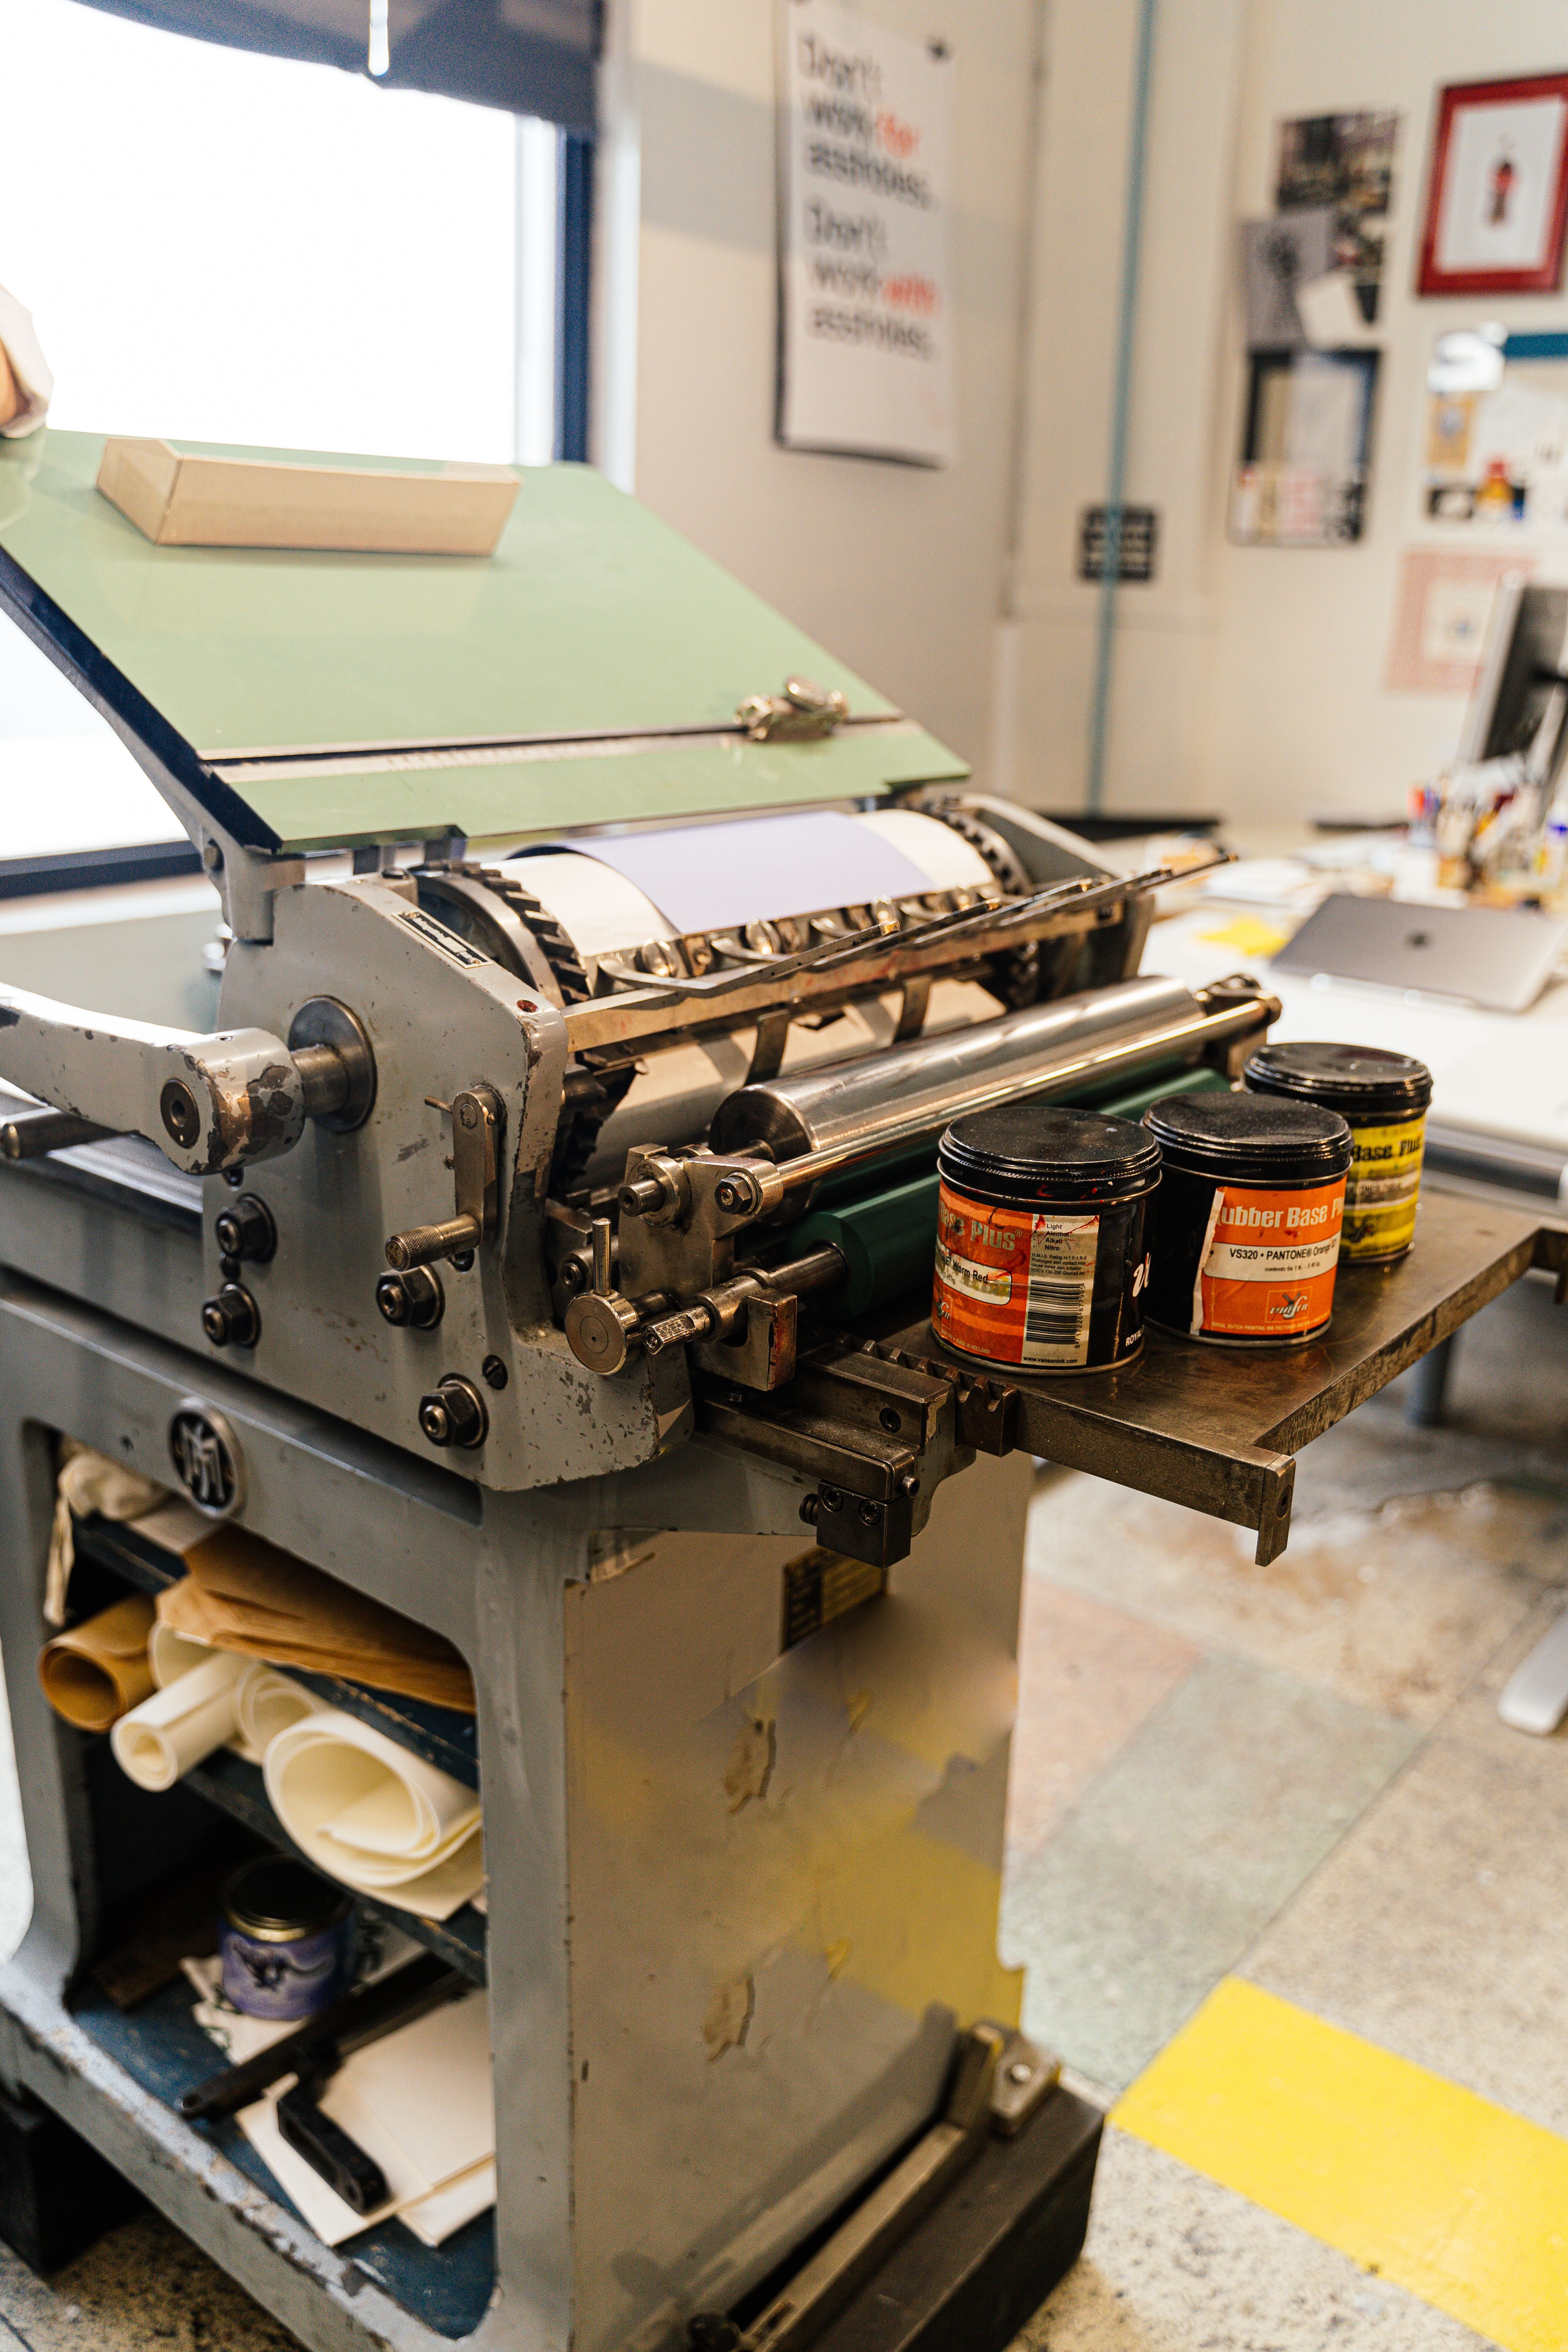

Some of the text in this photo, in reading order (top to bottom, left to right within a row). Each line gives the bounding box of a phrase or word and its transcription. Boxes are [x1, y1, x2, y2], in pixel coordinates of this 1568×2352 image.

[1216, 1206, 1284, 1228] ubber
[1286, 1205, 1328, 1227] Base
[1229, 1248, 1258, 1259] VS320
[953, 1260, 988, 1284] Warm Red
[971, 1345, 990, 1354] HOLLAND
